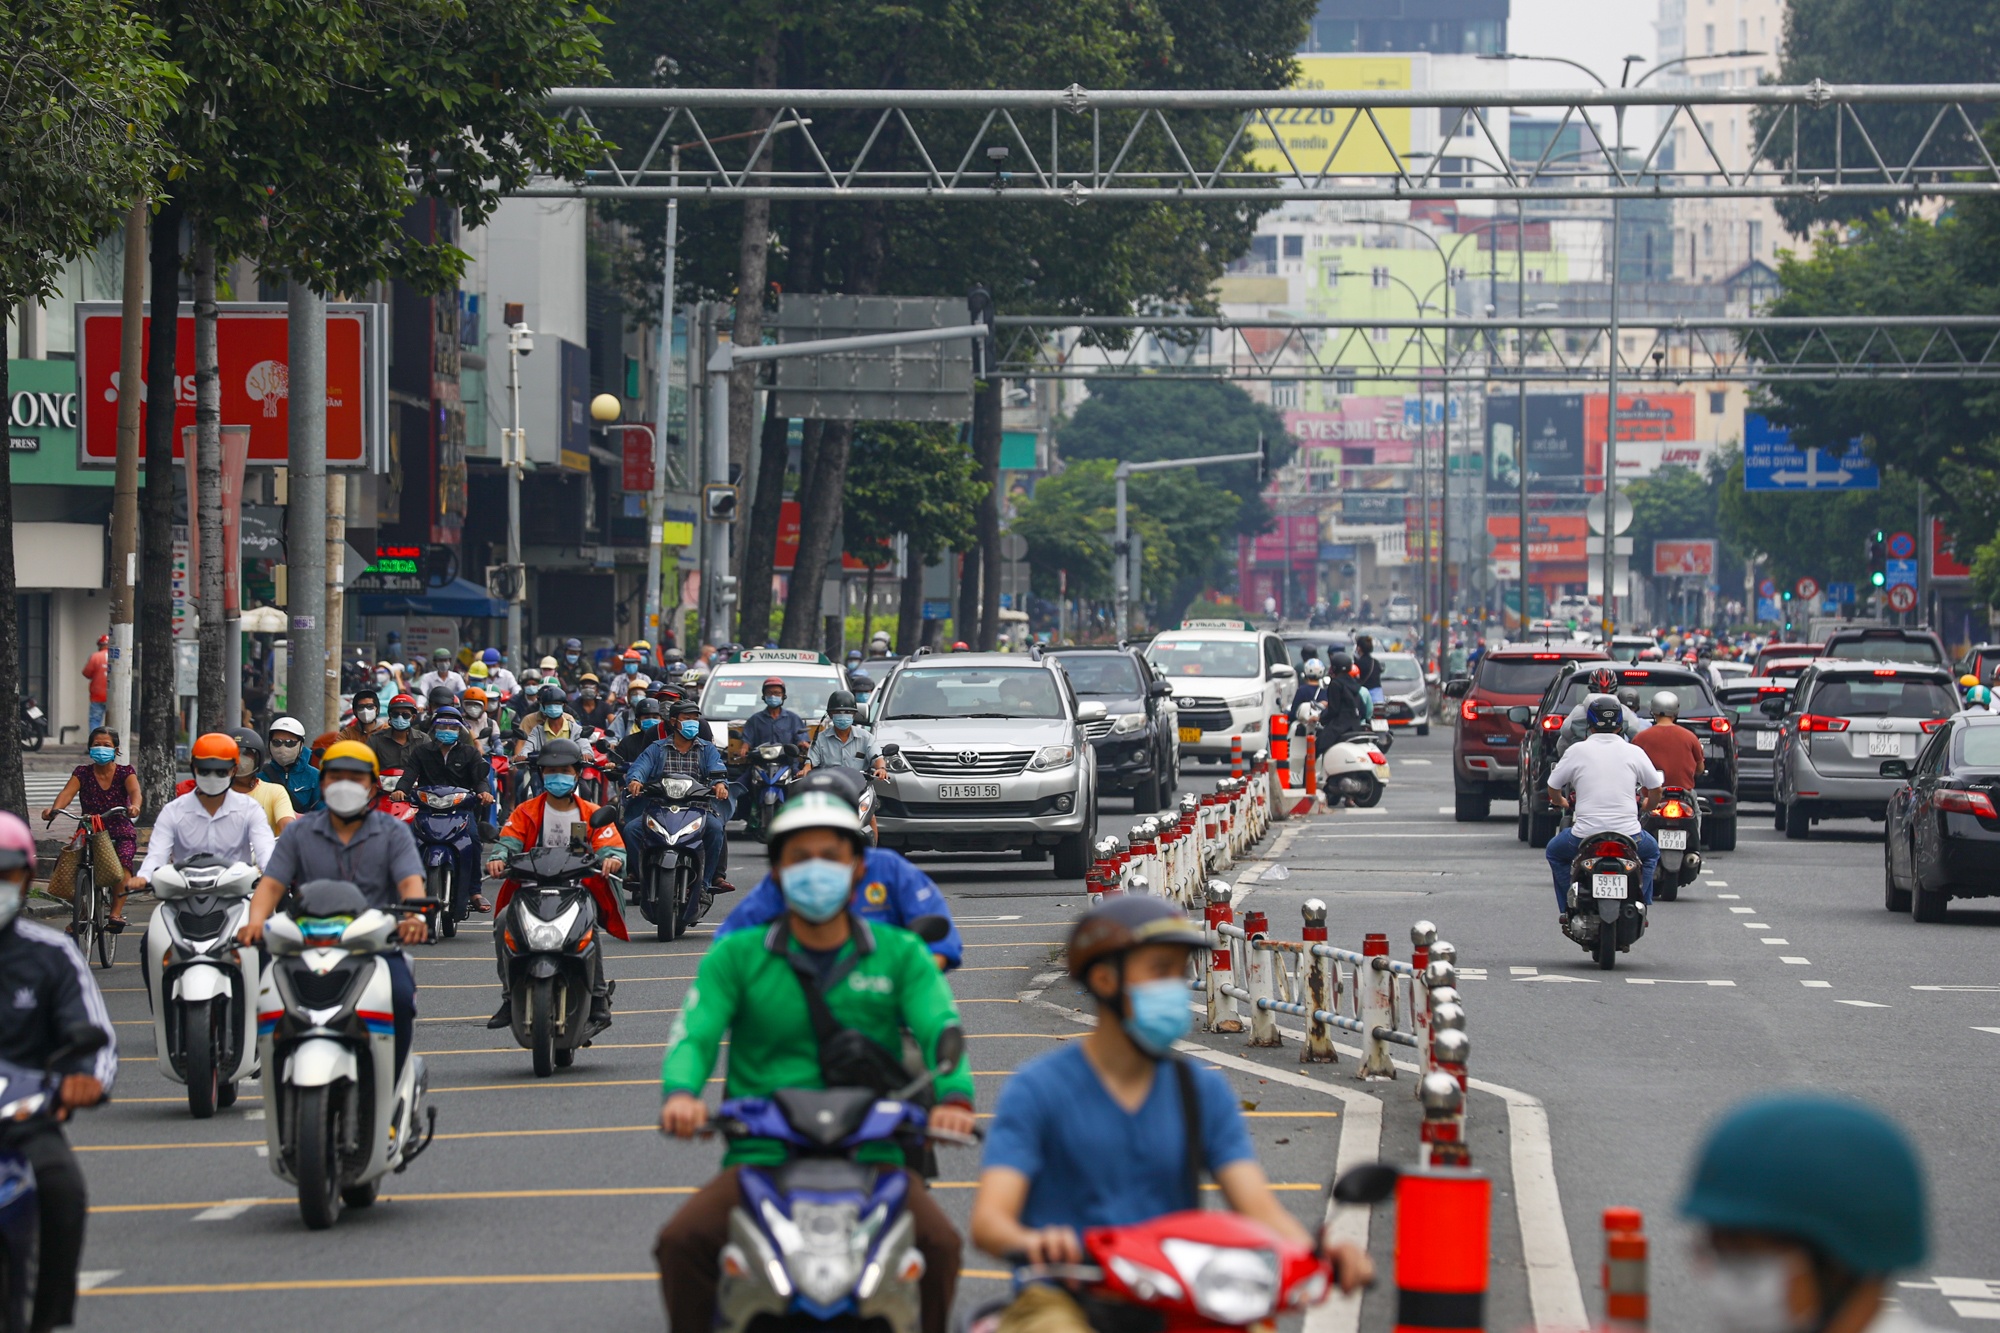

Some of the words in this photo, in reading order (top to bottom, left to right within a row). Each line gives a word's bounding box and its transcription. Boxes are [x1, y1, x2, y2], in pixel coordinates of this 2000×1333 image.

[10, 438, 37, 449] PRESS
[759, 652, 797, 660] VINASUN
[798, 653, 816, 661] TAXI
[941, 785, 998, 797] 51A-591.56
[1595, 886, 1625, 898] 452.11
